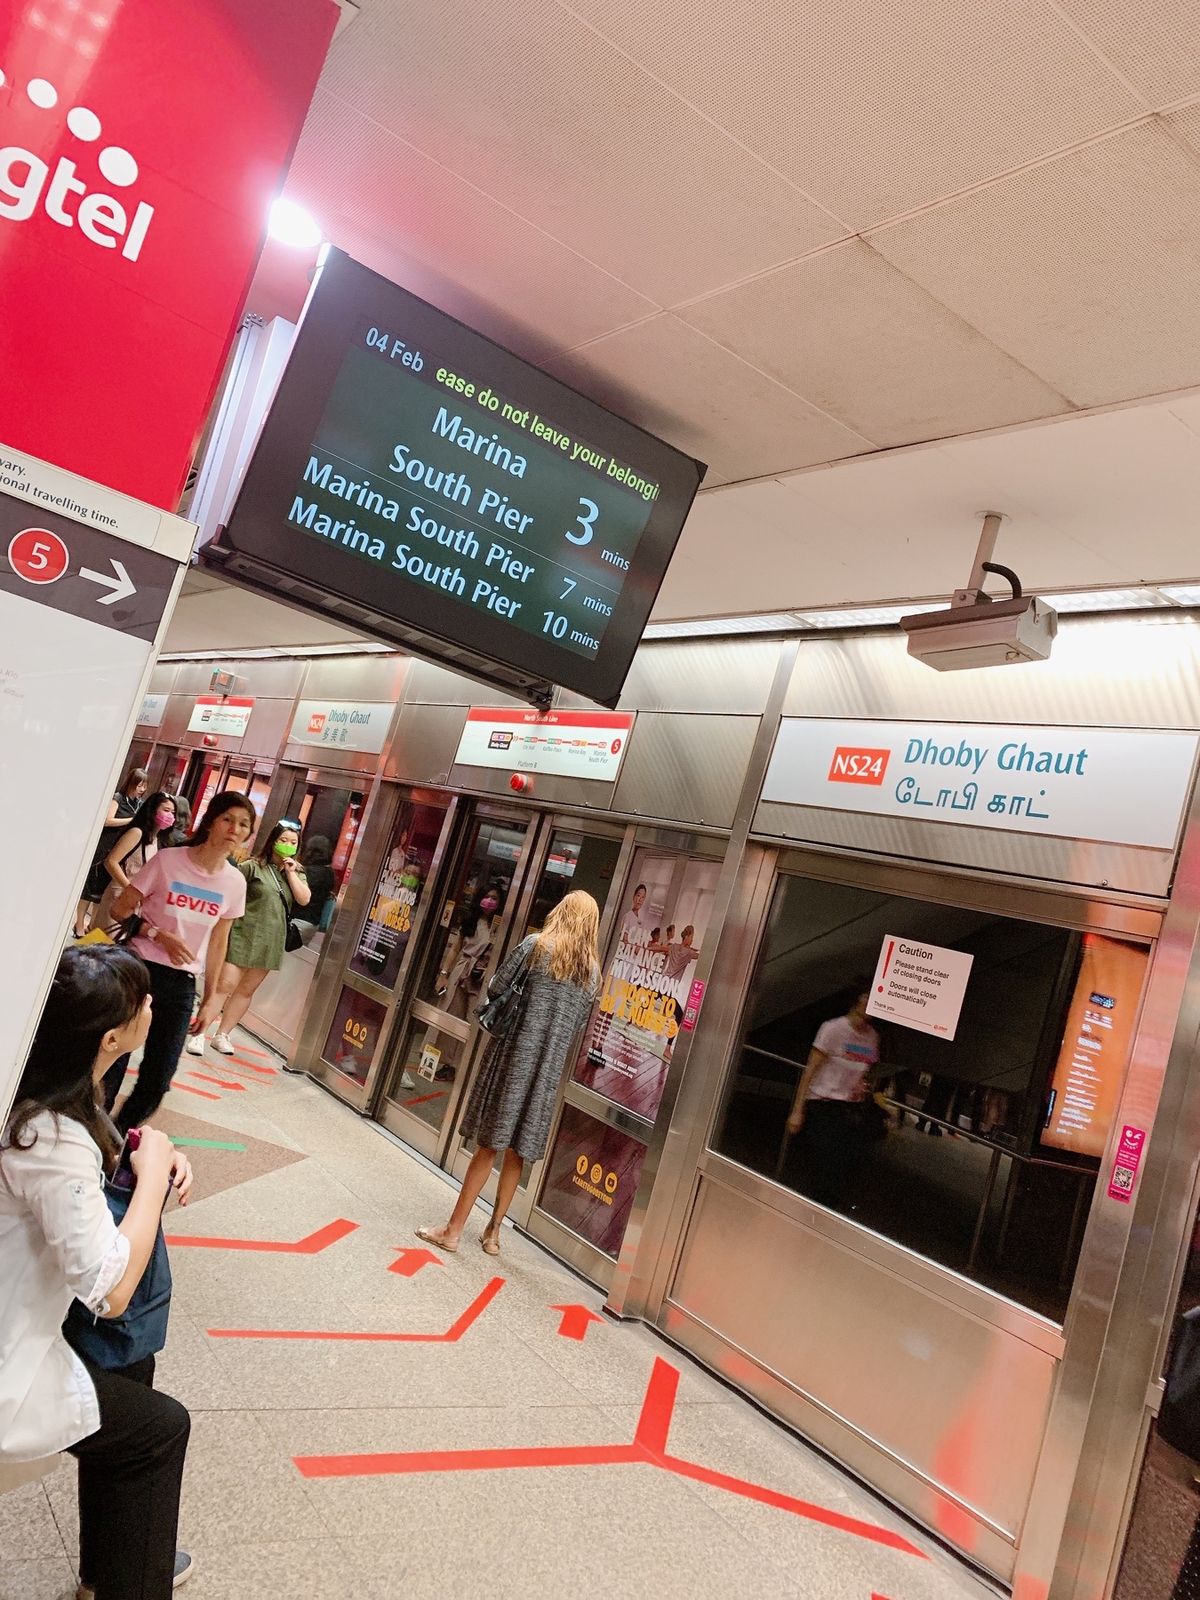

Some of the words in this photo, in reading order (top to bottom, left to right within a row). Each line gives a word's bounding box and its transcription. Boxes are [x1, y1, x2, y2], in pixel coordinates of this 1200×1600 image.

[366, 327, 389, 352] 04
[390, 340, 424, 372] Feb
[431, 406, 527, 479] Marina
[436, 367, 475, 398] ease
[478, 389, 499, 411] do
[502, 403, 529, 428] not
[530, 415, 570, 450] leave
[570, 443, 606, 470] your
[607, 458, 661, 501] belongi
[388, 444, 472, 506] South
[477, 488, 534, 535] Pier
[33, 486, 89, 518] travelling
[91, 509, 119, 528] time.
[303, 456, 400, 523] Marina
[405, 506, 480, 560] South
[485, 542, 535, 583] Pier
[559, 577, 577, 600] 7
[583, 596, 613, 617] mins
[564, 497, 599, 546] 3
[600, 549, 631, 571] mins
[27, 542, 51, 570] 5
[288, 495, 386, 560] Marina
[391, 544, 466, 596] South
[471, 579, 522, 619] Pier
[542, 611, 568, 639] 10
[570, 629, 600, 650] mins
[328, 709, 348, 726] Dhoby
[350, 710, 371, 724] Ghaut
[833, 754, 883, 777] NS24
[904, 738, 989, 774] Dhoby
[997, 742, 1088, 775] Ghaut
[895, 776, 979, 810] டோபி
[987, 789, 1049, 819] காட்
[615, 941, 666, 973] BALANCE
[899, 944, 933, 960] Caution
[895, 960, 915, 970] Please
[916, 965, 933, 975] stand
[933, 970, 950, 979] clear
[900, 970, 922, 982] closing
[923, 976, 941, 986] doors
[874, 1000, 887, 1009] Thank
[887, 990, 927, 1007] automatically
[889, 980, 908, 992] Doors
[908, 987, 920, 995] will
[920, 990, 937, 1000] close
